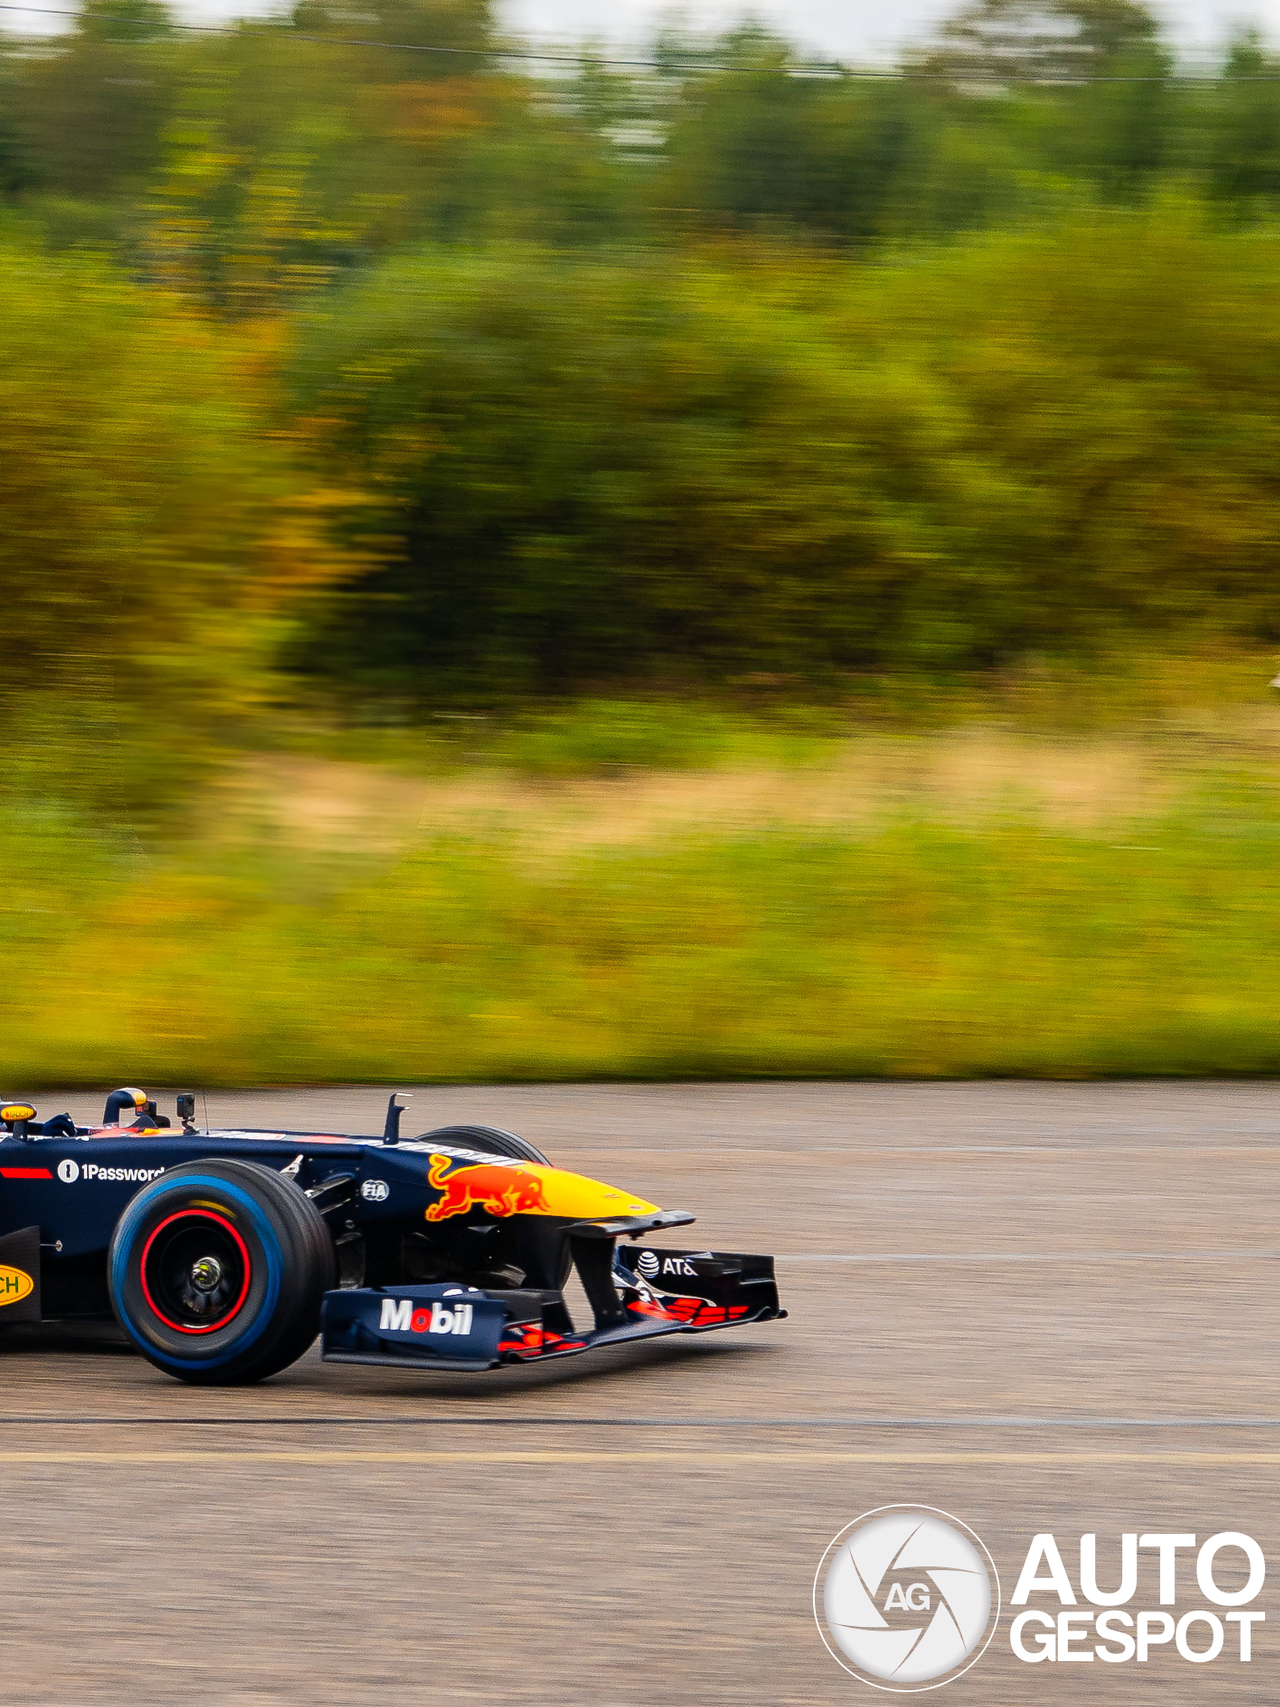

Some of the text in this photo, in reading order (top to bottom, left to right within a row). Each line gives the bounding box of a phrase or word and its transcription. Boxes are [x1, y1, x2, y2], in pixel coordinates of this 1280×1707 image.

[362, 1184, 387, 1197] FIA
[662, 1258, 700, 1276] AT&
[379, 1299, 473, 1336] Mobil
